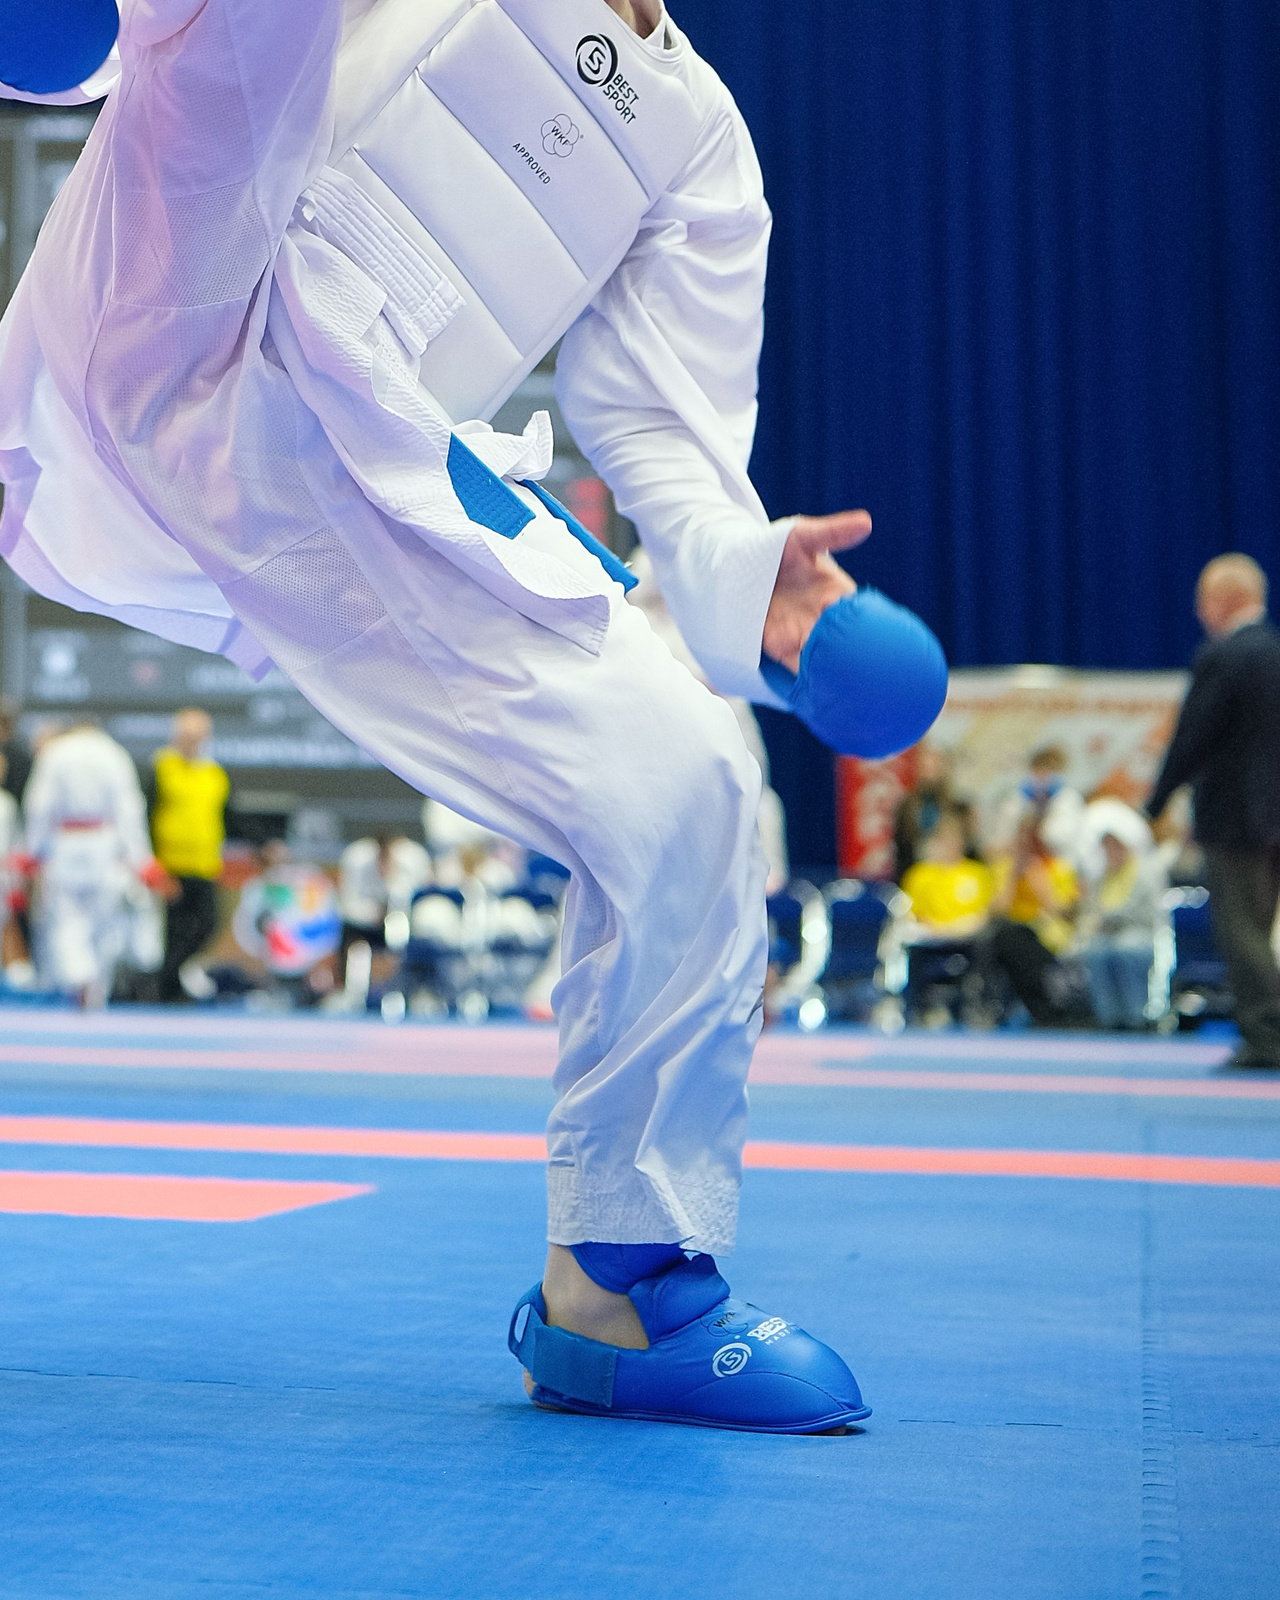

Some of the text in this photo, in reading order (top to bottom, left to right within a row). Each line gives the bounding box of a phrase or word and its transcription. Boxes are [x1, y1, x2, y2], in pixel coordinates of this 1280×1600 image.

[603, 85, 637, 124] SPORT
[613, 74, 639, 105] BEST
[551, 126, 570, 146] WKF
[512, 142, 551, 184] APPROVED
